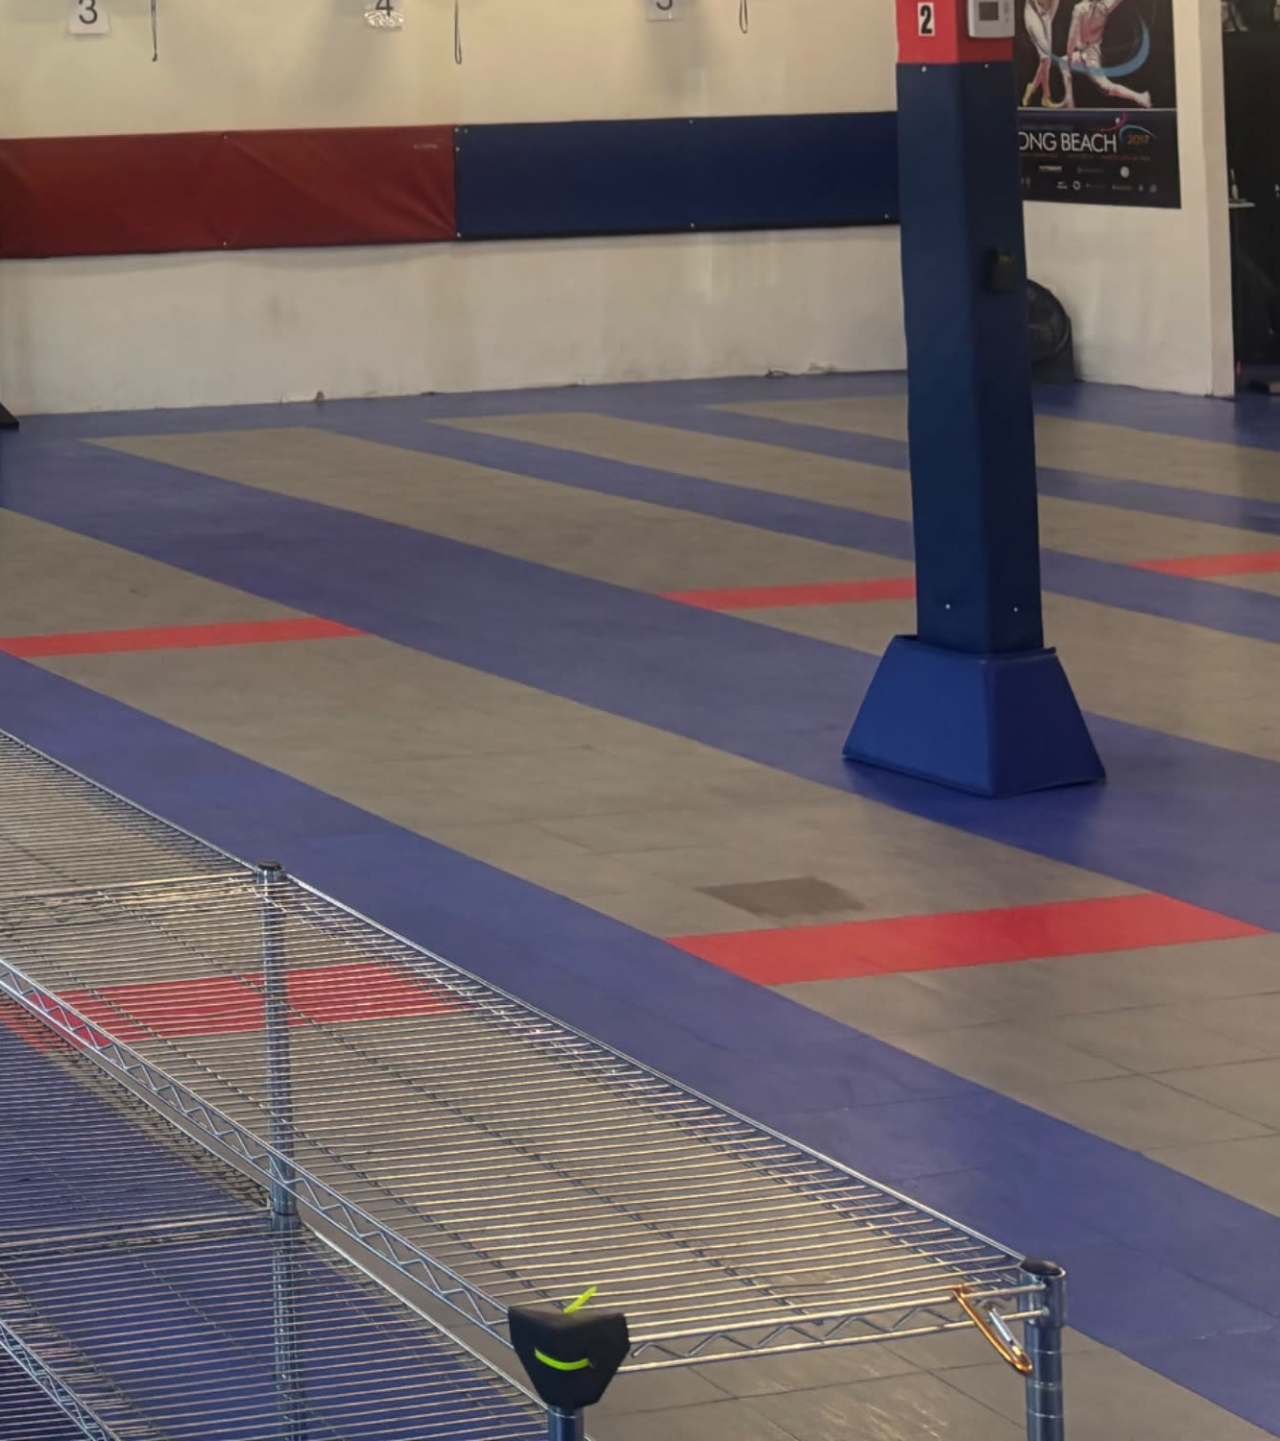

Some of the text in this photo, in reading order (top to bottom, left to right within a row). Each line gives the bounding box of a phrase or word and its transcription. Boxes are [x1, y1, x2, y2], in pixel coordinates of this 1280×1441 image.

[920, 4, 933, 34] 2
[1018, 131, 1057, 152] ONG
[1060, 132, 1117, 153] BEACH
